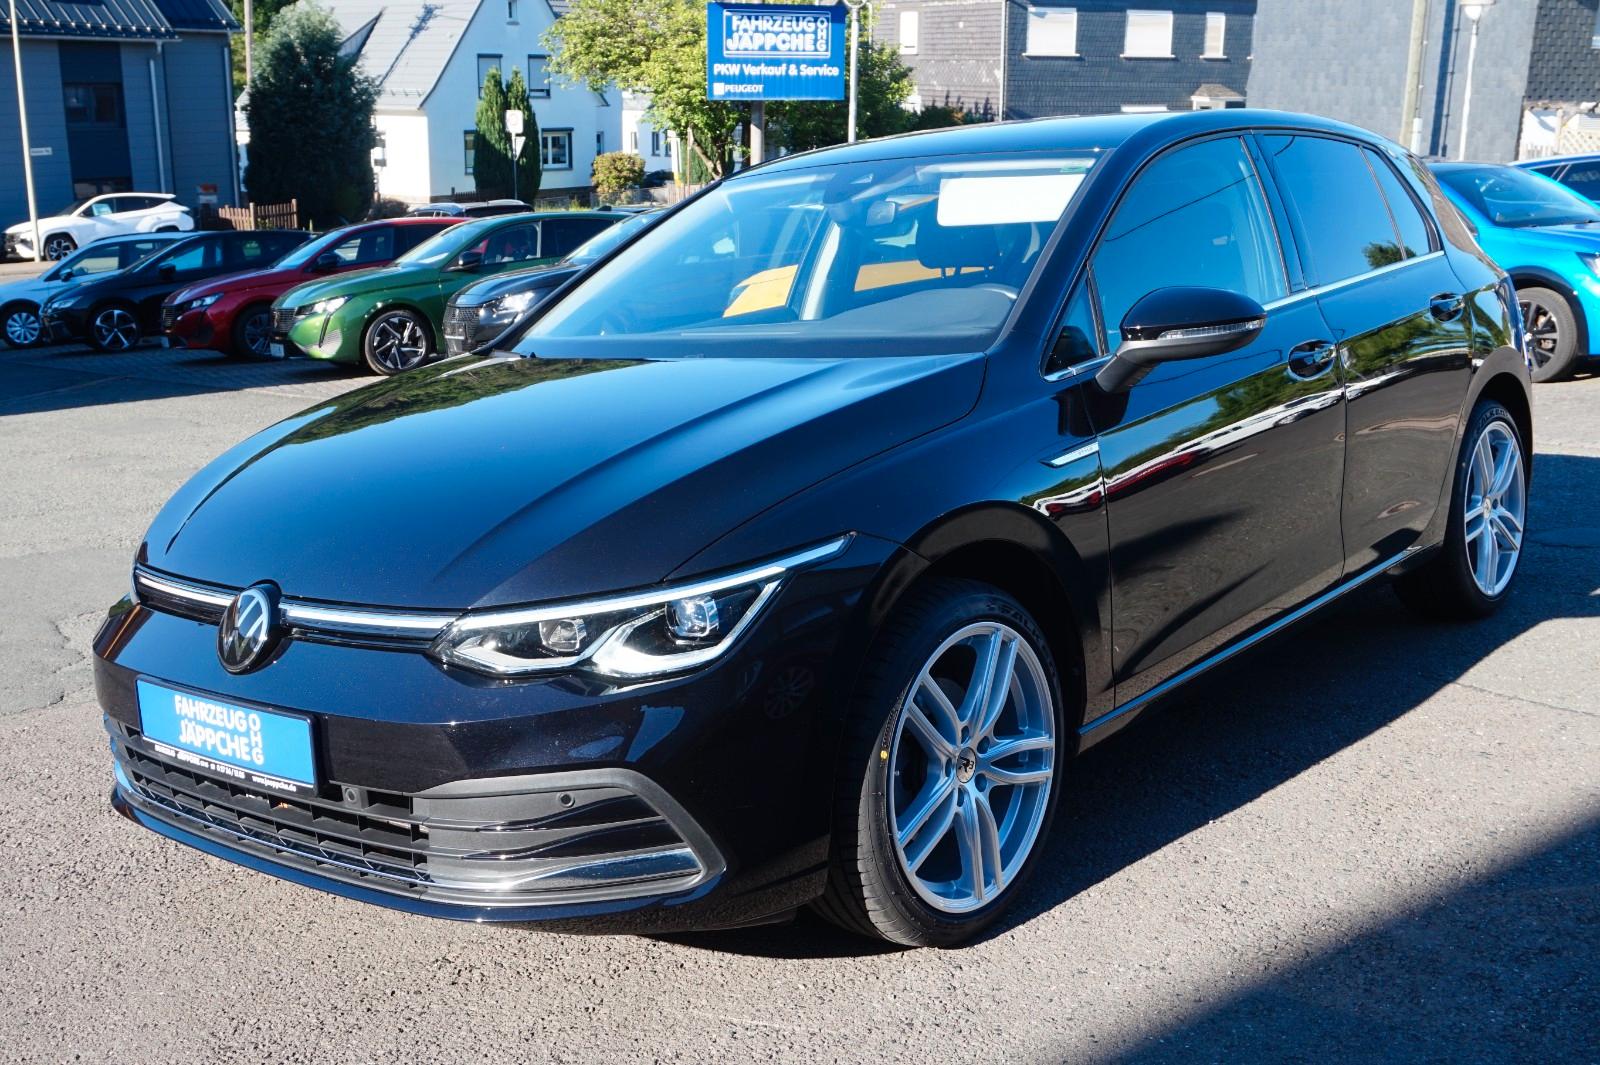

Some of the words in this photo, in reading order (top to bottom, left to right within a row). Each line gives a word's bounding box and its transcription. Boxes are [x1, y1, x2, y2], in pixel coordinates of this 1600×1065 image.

[731, 15, 816, 32] FAHRZEUG
[816, 17, 828, 51] OHG
[726, 30, 816, 51] JÄPPCHE
[713, 63, 740, 76] PKW
[743, 63, 787, 76] Verkauf
[788, 64, 798, 76] &
[799, 63, 839, 76] Service
[724, 84, 764, 93] PEUGEOT
[174, 694, 248, 733] FAHRZEUG
[178, 719, 251, 761] JÄPPCHE
[248, 713, 265, 765] OHG
